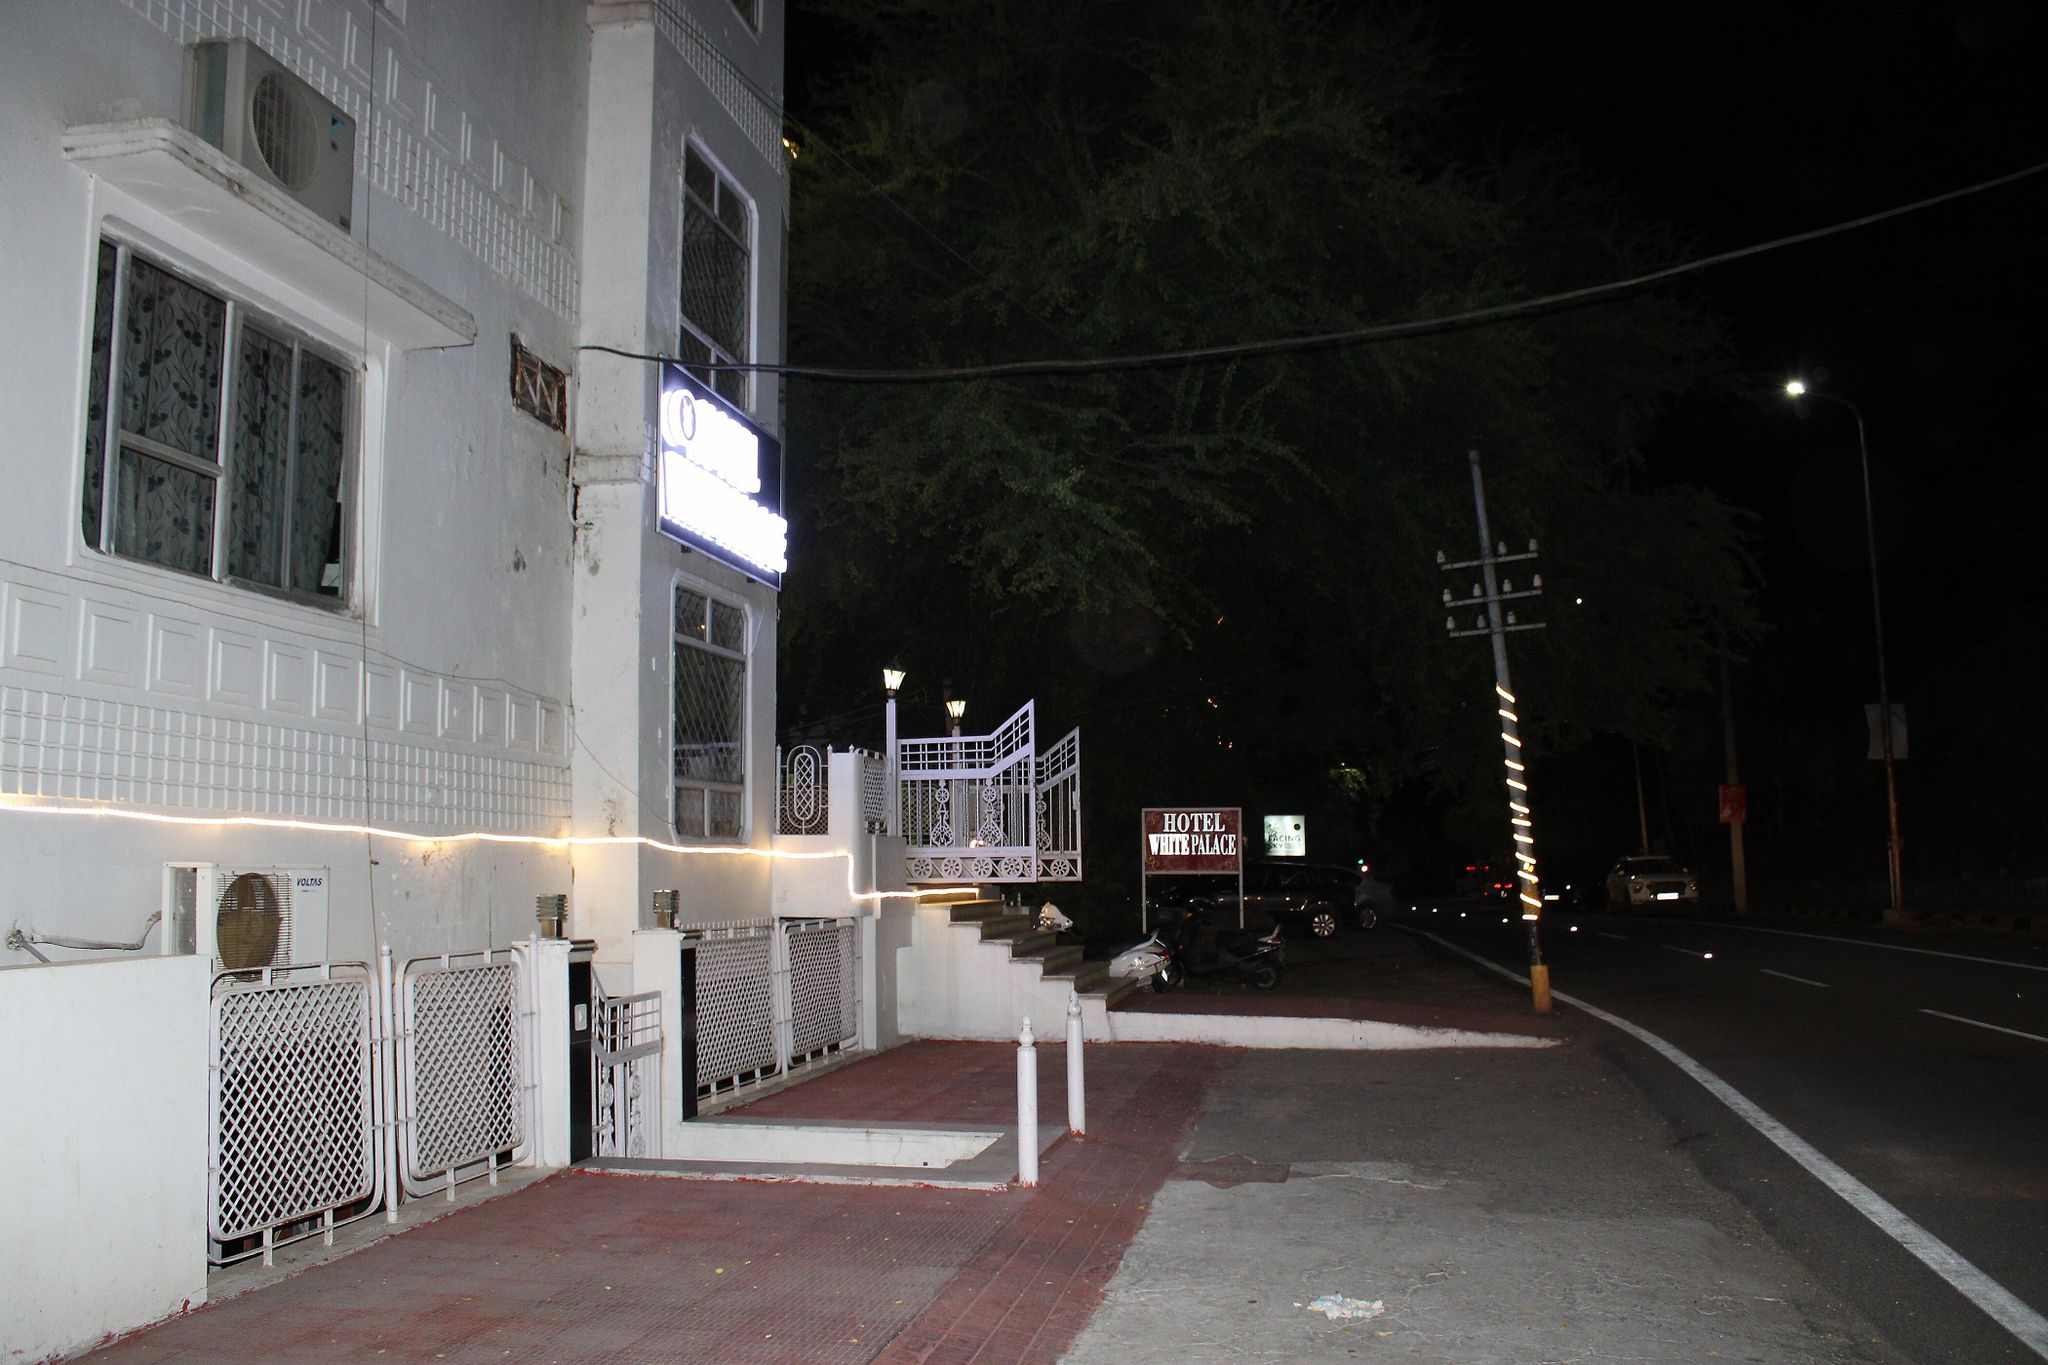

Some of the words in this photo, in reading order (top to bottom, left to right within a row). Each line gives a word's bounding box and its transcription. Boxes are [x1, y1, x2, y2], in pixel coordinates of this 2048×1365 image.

[1163, 813, 1225, 832] HOTEL
[1148, 833, 1190, 855] WHITE
[1191, 834, 1236, 855] PALACE
[296, 878, 322, 886] VOLTAS
